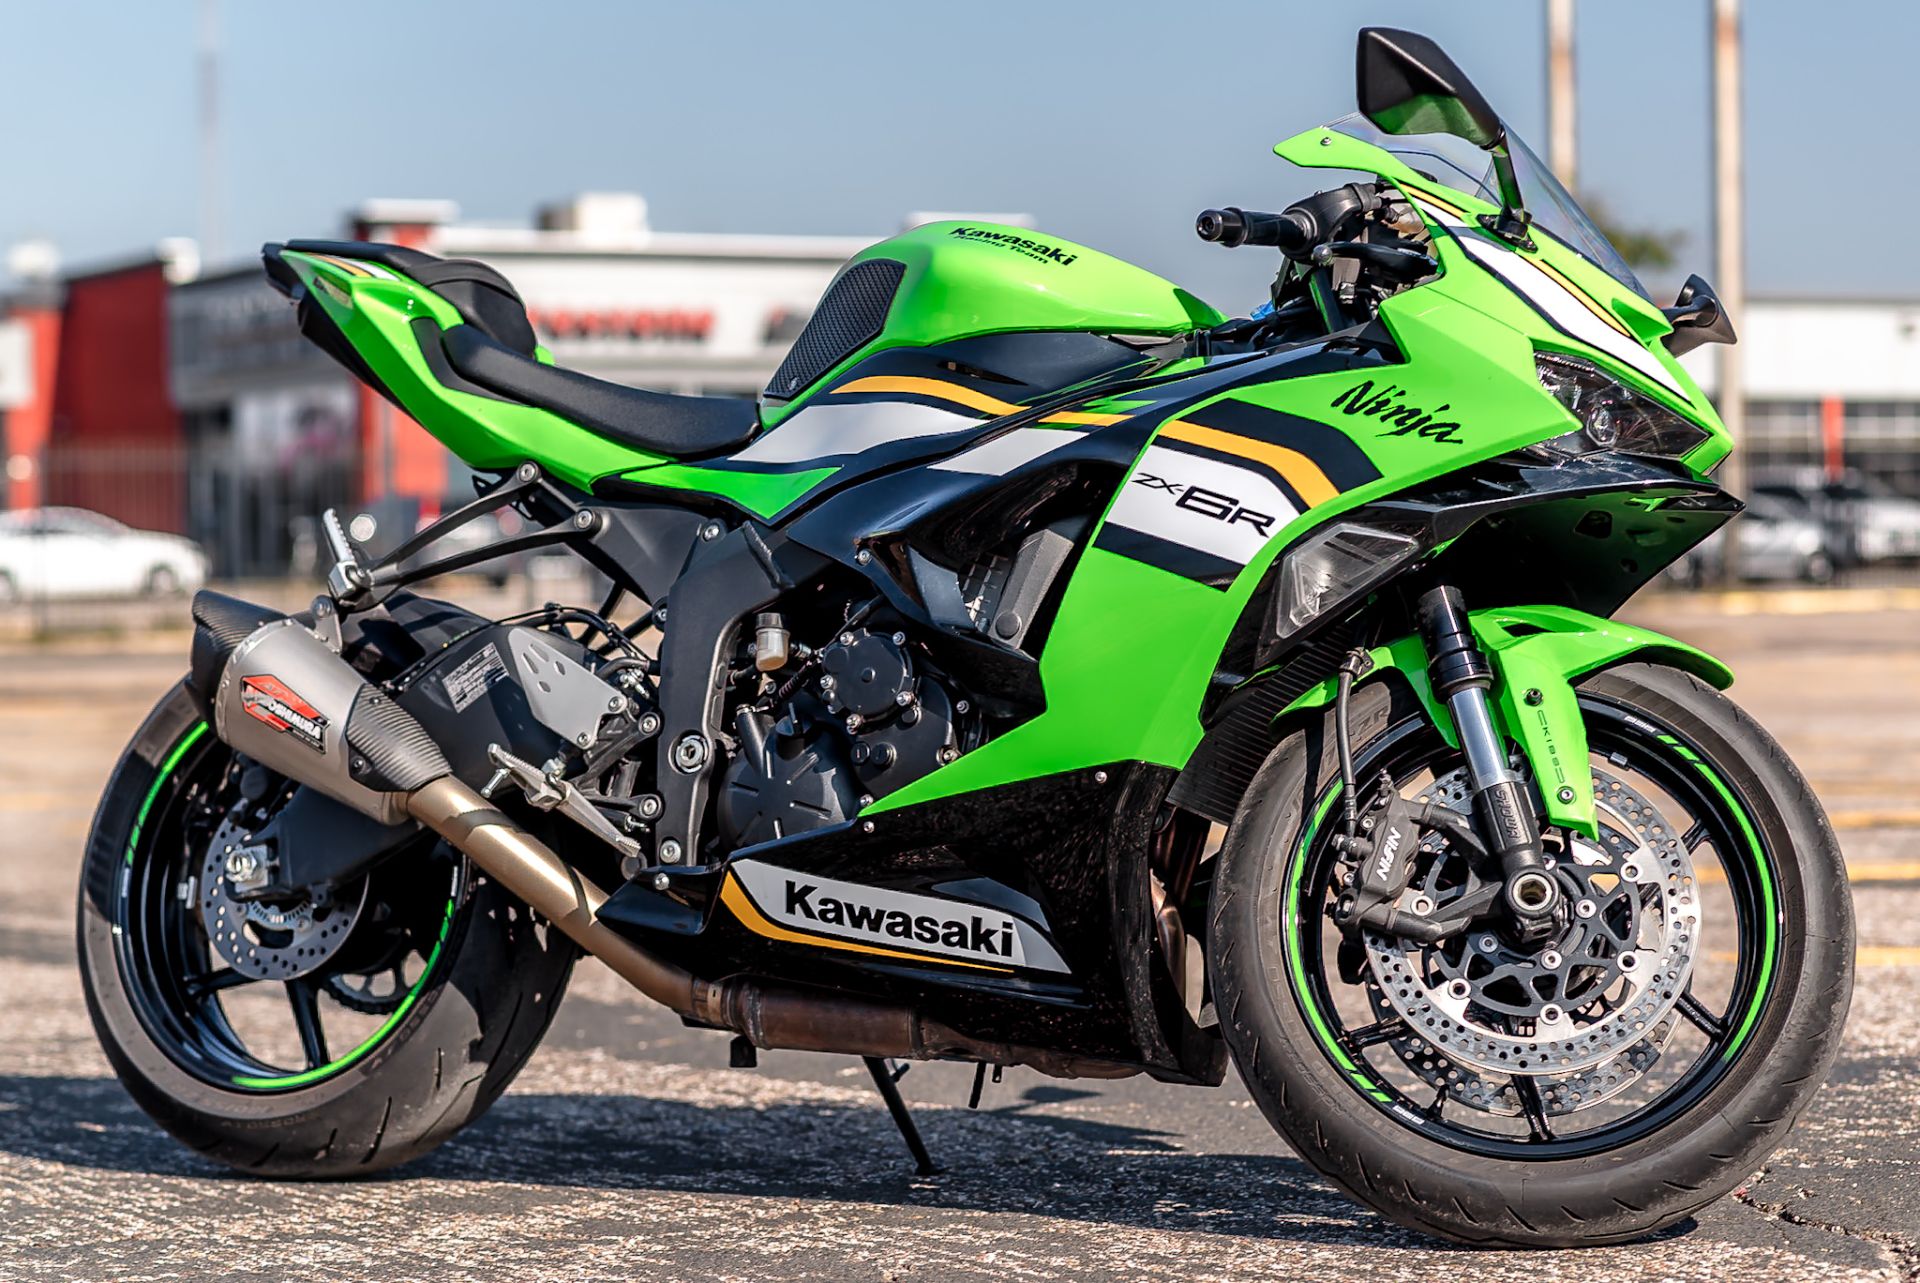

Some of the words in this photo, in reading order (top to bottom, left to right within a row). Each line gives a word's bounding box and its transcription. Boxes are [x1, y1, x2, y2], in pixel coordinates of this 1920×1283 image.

[949, 227, 1078, 266] Kawasaki
[1009, 246, 1049, 265] Team
[1330, 380, 1463, 444] Ninja
[1495, 789, 1519, 839] SHOWA
[1376, 826, 1402, 882] NISSIN
[785, 880, 1013, 957] Kawasaki
